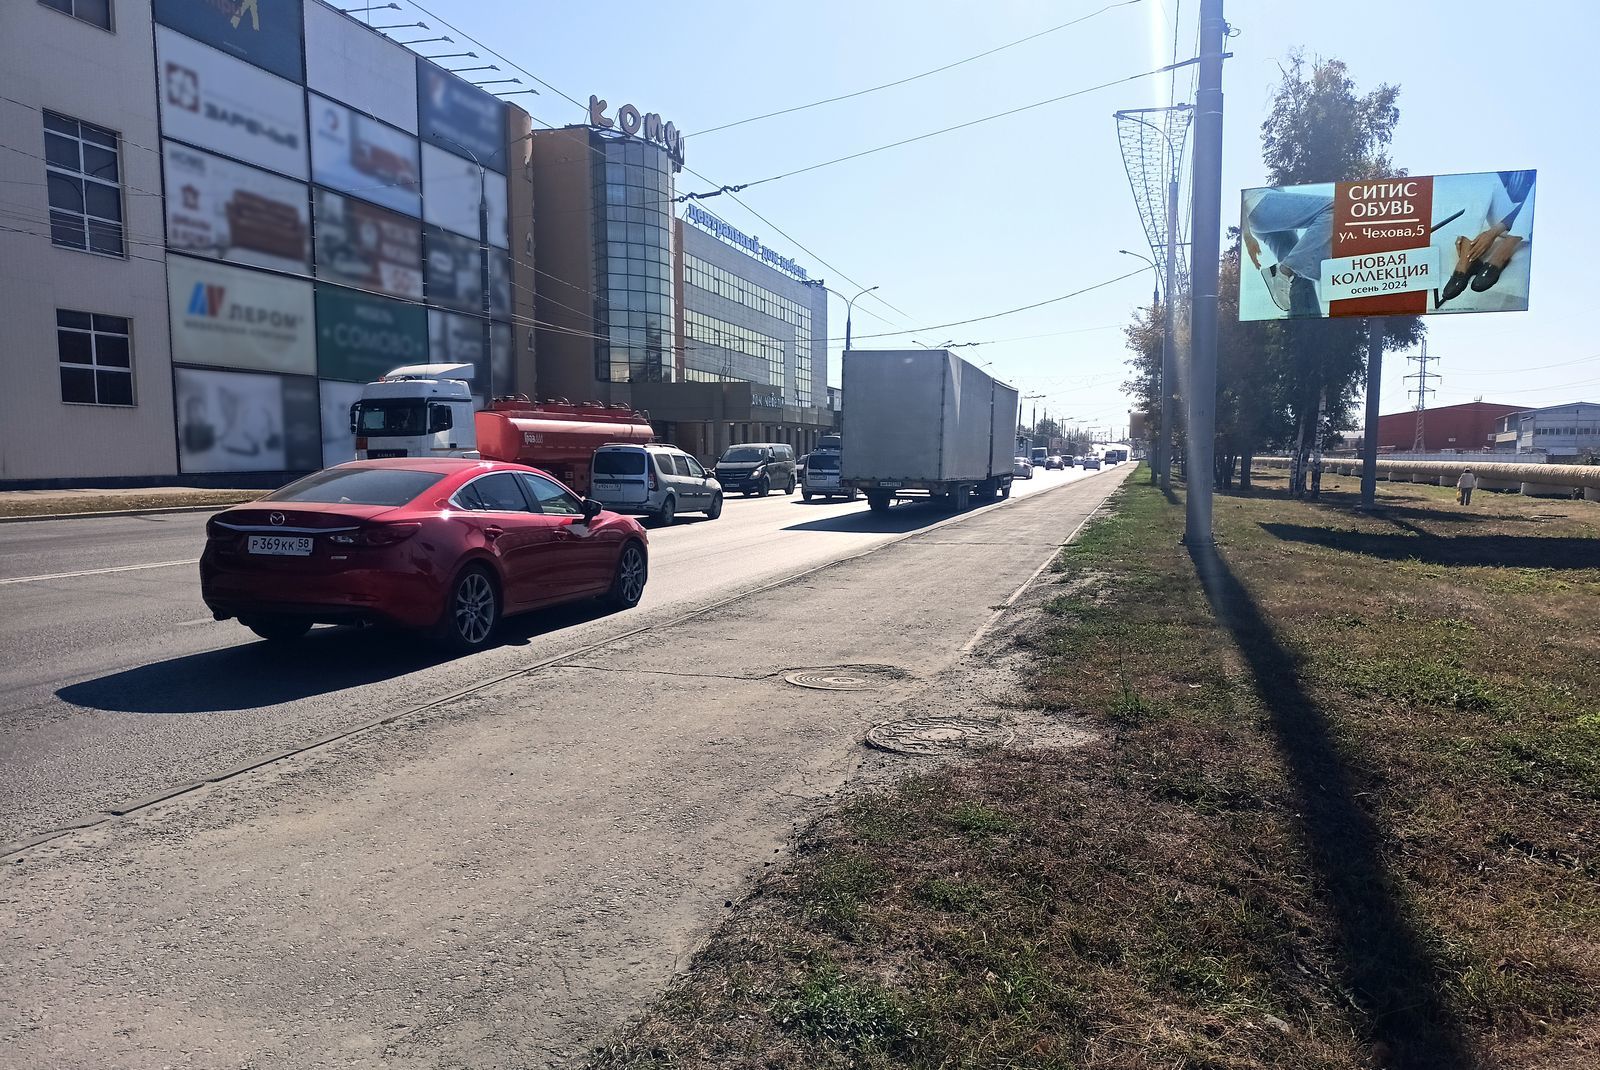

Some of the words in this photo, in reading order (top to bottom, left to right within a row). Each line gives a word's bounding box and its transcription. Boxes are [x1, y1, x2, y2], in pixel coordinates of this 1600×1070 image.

[1348, 181, 1418, 201] СИТИС
[1350, 201, 1415, 218] ОБУВЬ
[1338, 229, 1358, 243] ул.
[1351, 253, 1407, 271] НОВАЯ
[1331, 263, 1429, 286] КОЛЛЕКЦИЯ
[1351, 283, 1379, 295] осень
[1381, 280, 1408, 291] 2024
